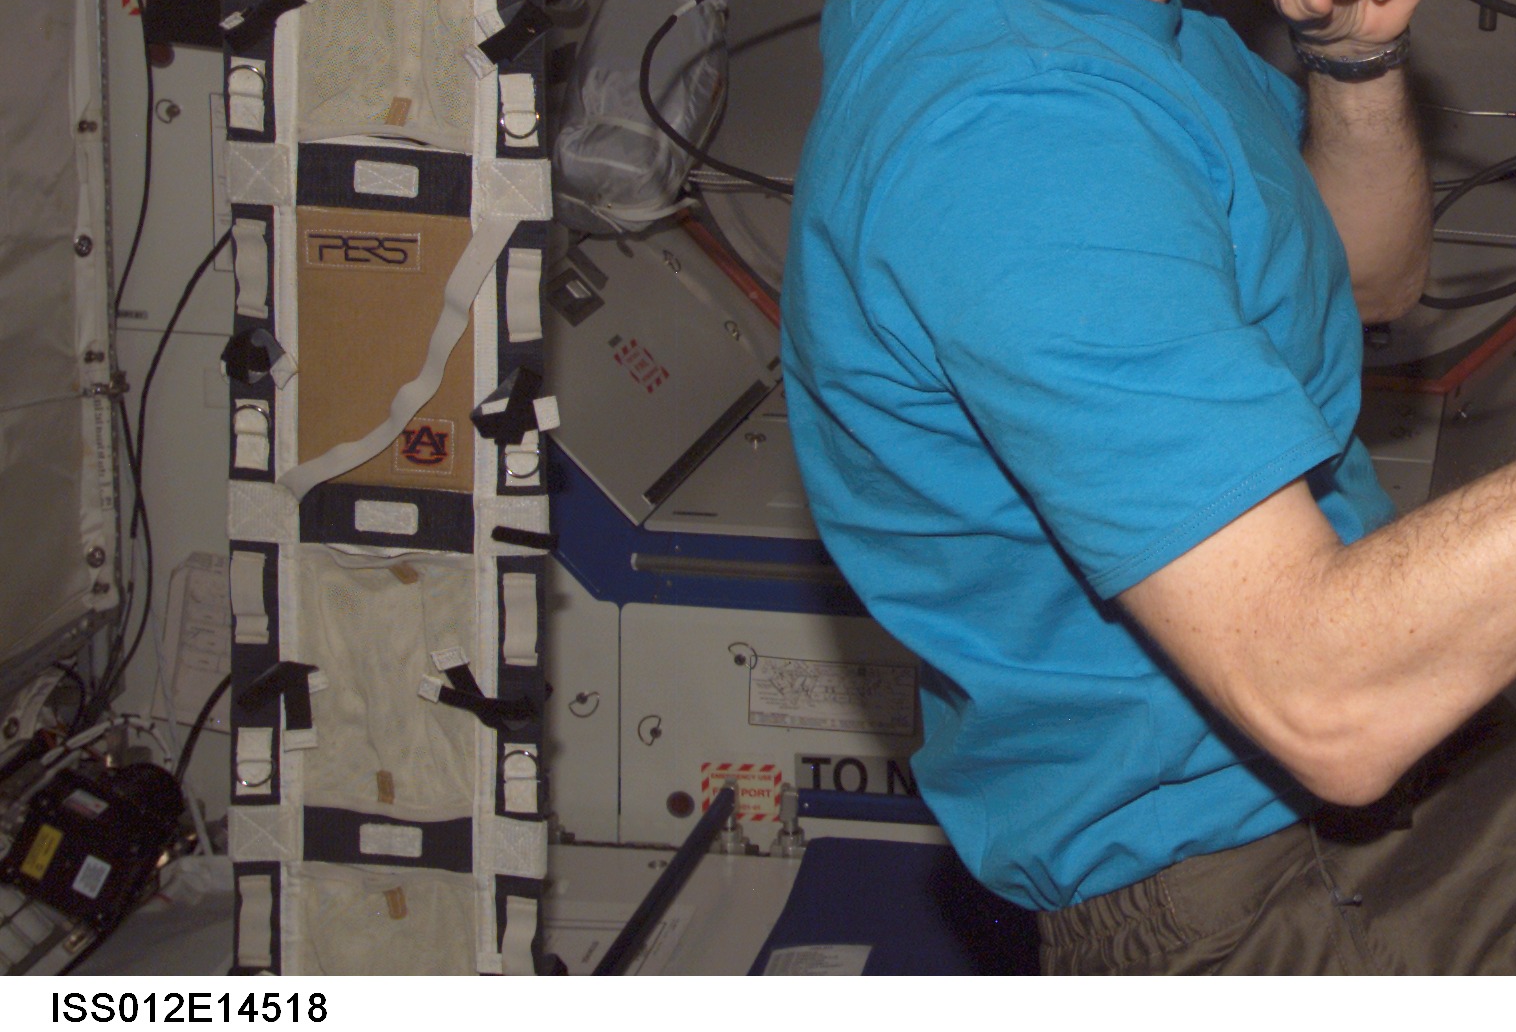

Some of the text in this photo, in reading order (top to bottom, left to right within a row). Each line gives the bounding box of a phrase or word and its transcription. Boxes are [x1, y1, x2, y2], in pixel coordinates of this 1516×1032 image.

[308, 233, 418, 264] PERS
[801, 756, 868, 793] TO
[741, 788, 772, 799] PORT
